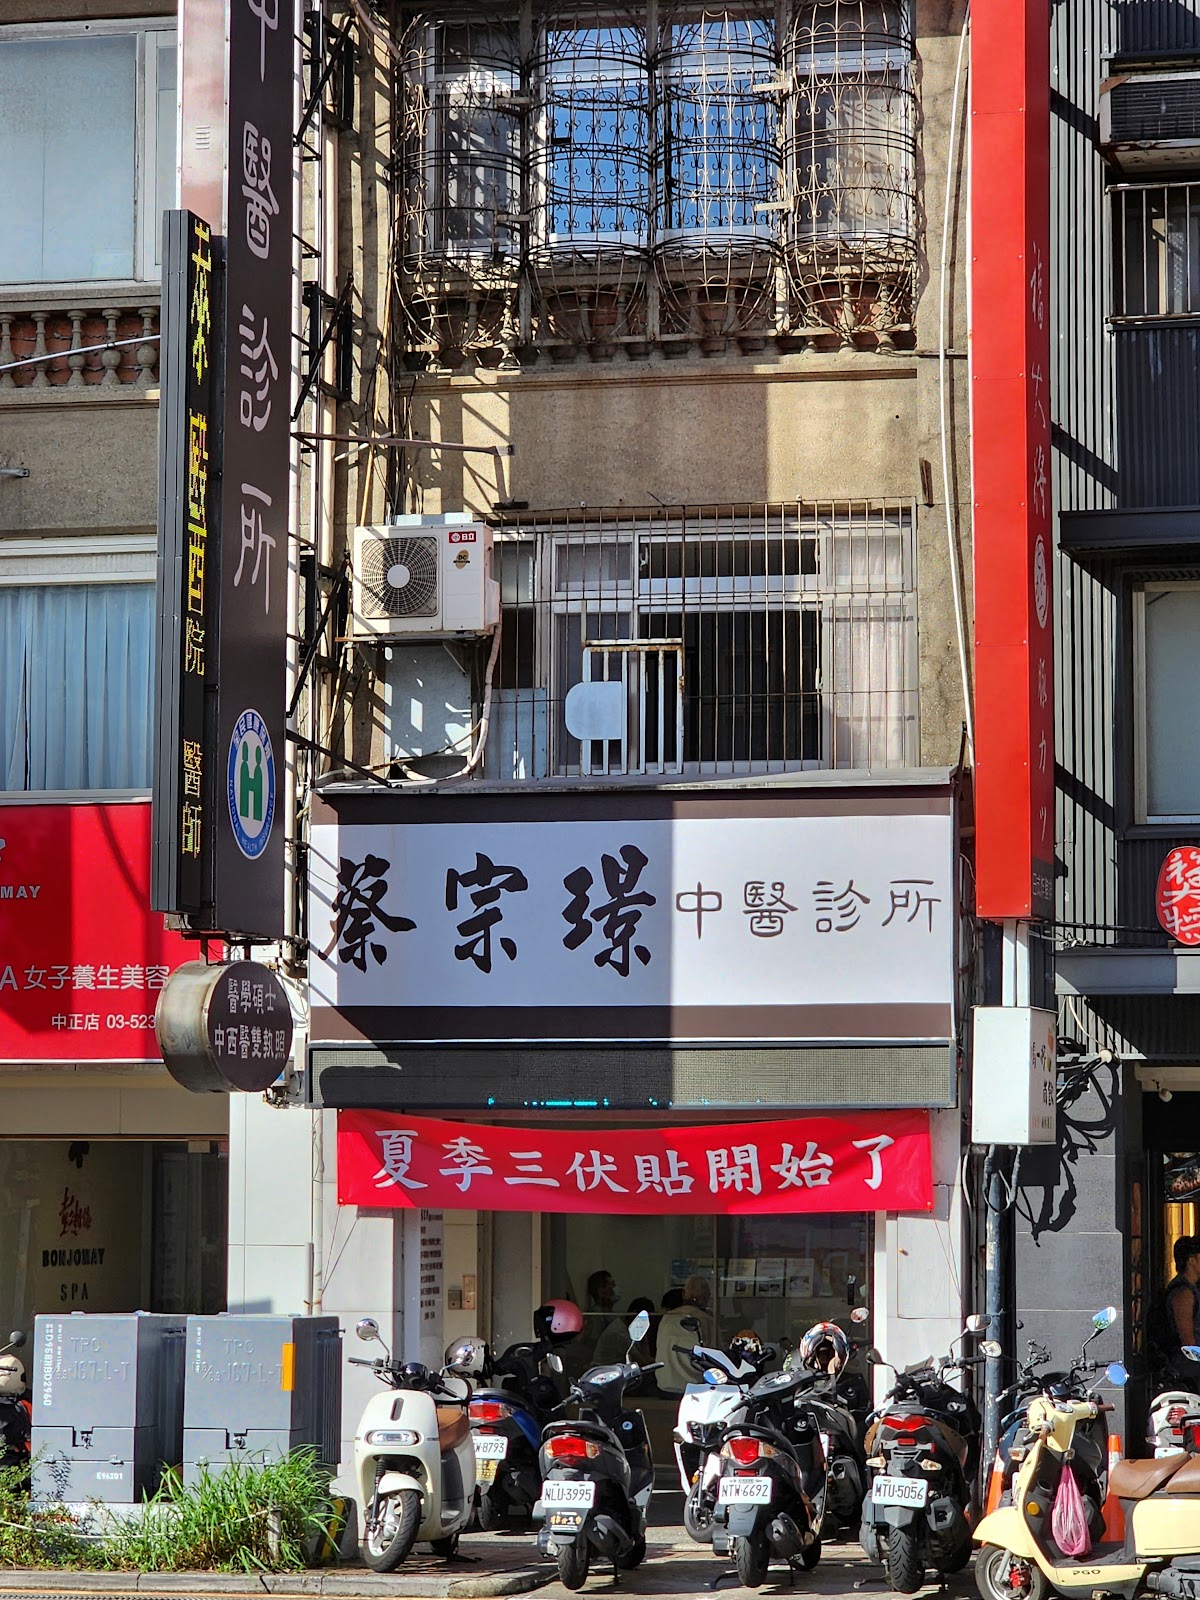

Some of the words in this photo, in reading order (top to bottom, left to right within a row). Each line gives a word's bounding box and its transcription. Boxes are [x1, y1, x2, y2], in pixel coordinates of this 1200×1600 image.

[319, 845, 657, 978] 蔡宗璟
[675, 879, 942, 940] 中醫診所
[23, 964, 170, 990] 女子養生美容
[227, 977, 277, 1015] 醫學碩士
[51, 1013, 100, 1031] 中正店
[214, 1022, 286, 1060] 中西醫雙執照
[372, 1129, 896, 1198] 夏季三伏貼開始了
[42, 1248, 105, 1268] BONJOMAY
[60, 1282, 89, 1302] SPA
[473, 1442, 505, 1454] W-8793
